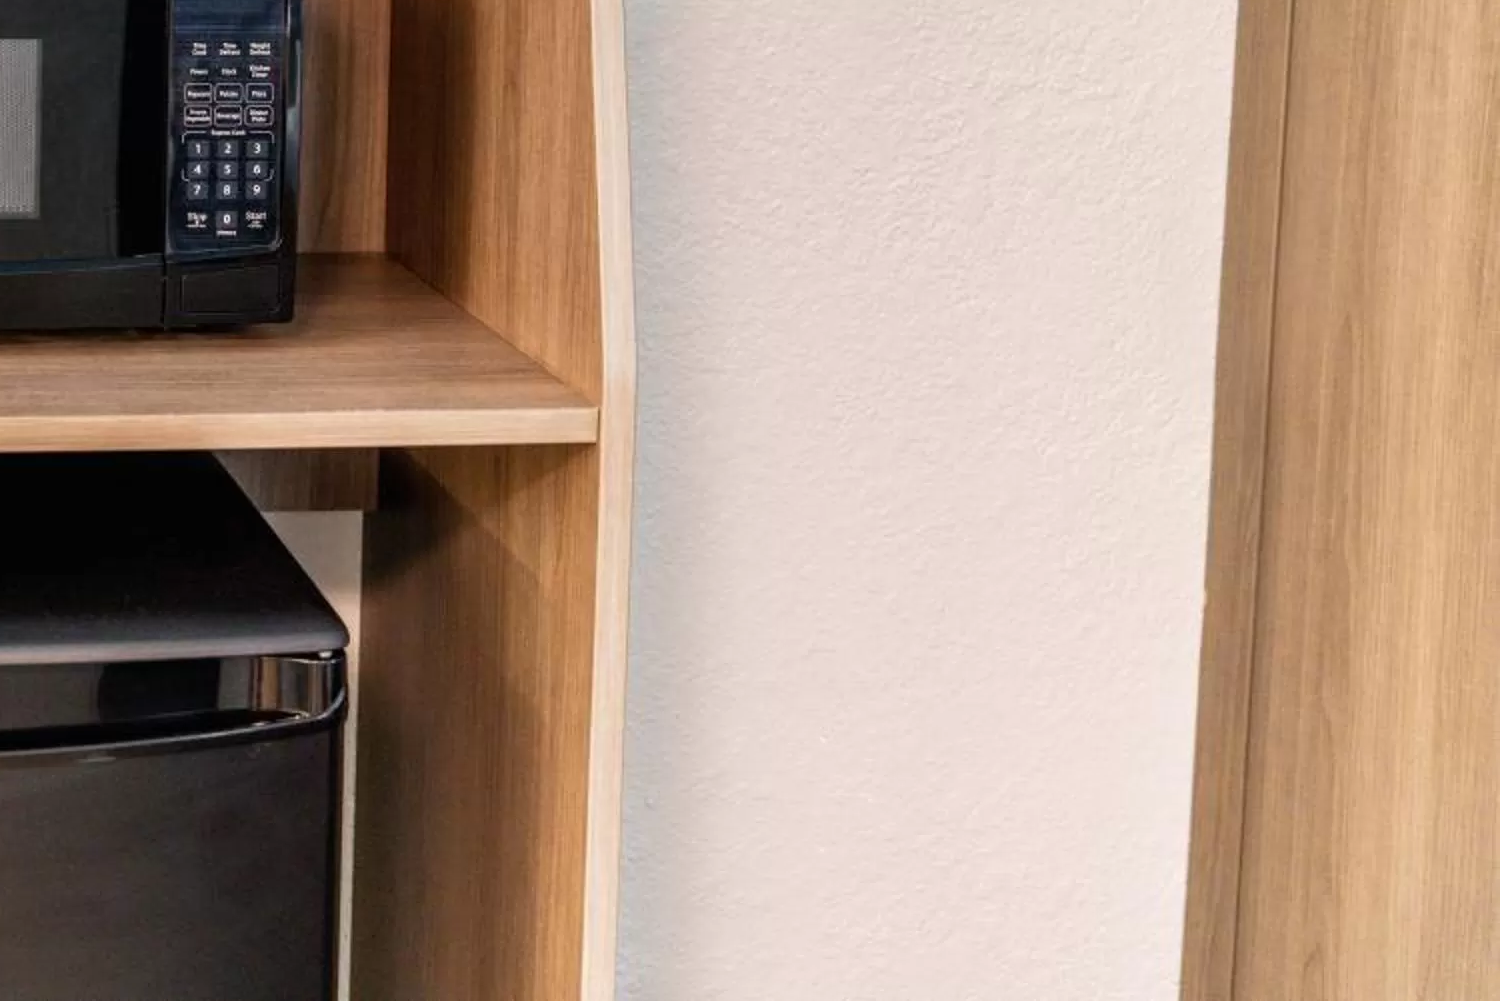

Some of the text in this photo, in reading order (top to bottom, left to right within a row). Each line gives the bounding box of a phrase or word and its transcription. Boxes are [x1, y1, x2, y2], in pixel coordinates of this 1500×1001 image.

[195, 143, 202, 154] 1
[224, 143, 232, 154] 2
[253, 143, 262, 154] 3
[193, 164, 202, 174] 4
[223, 164, 232, 174] 5
[253, 164, 261, 174] 6
[193, 184, 202, 195] 7
[223, 184, 231, 195] 8
[253, 184, 261, 195] 9
[223, 214, 231, 224] 0
[245, 211, 267, 220] Start
